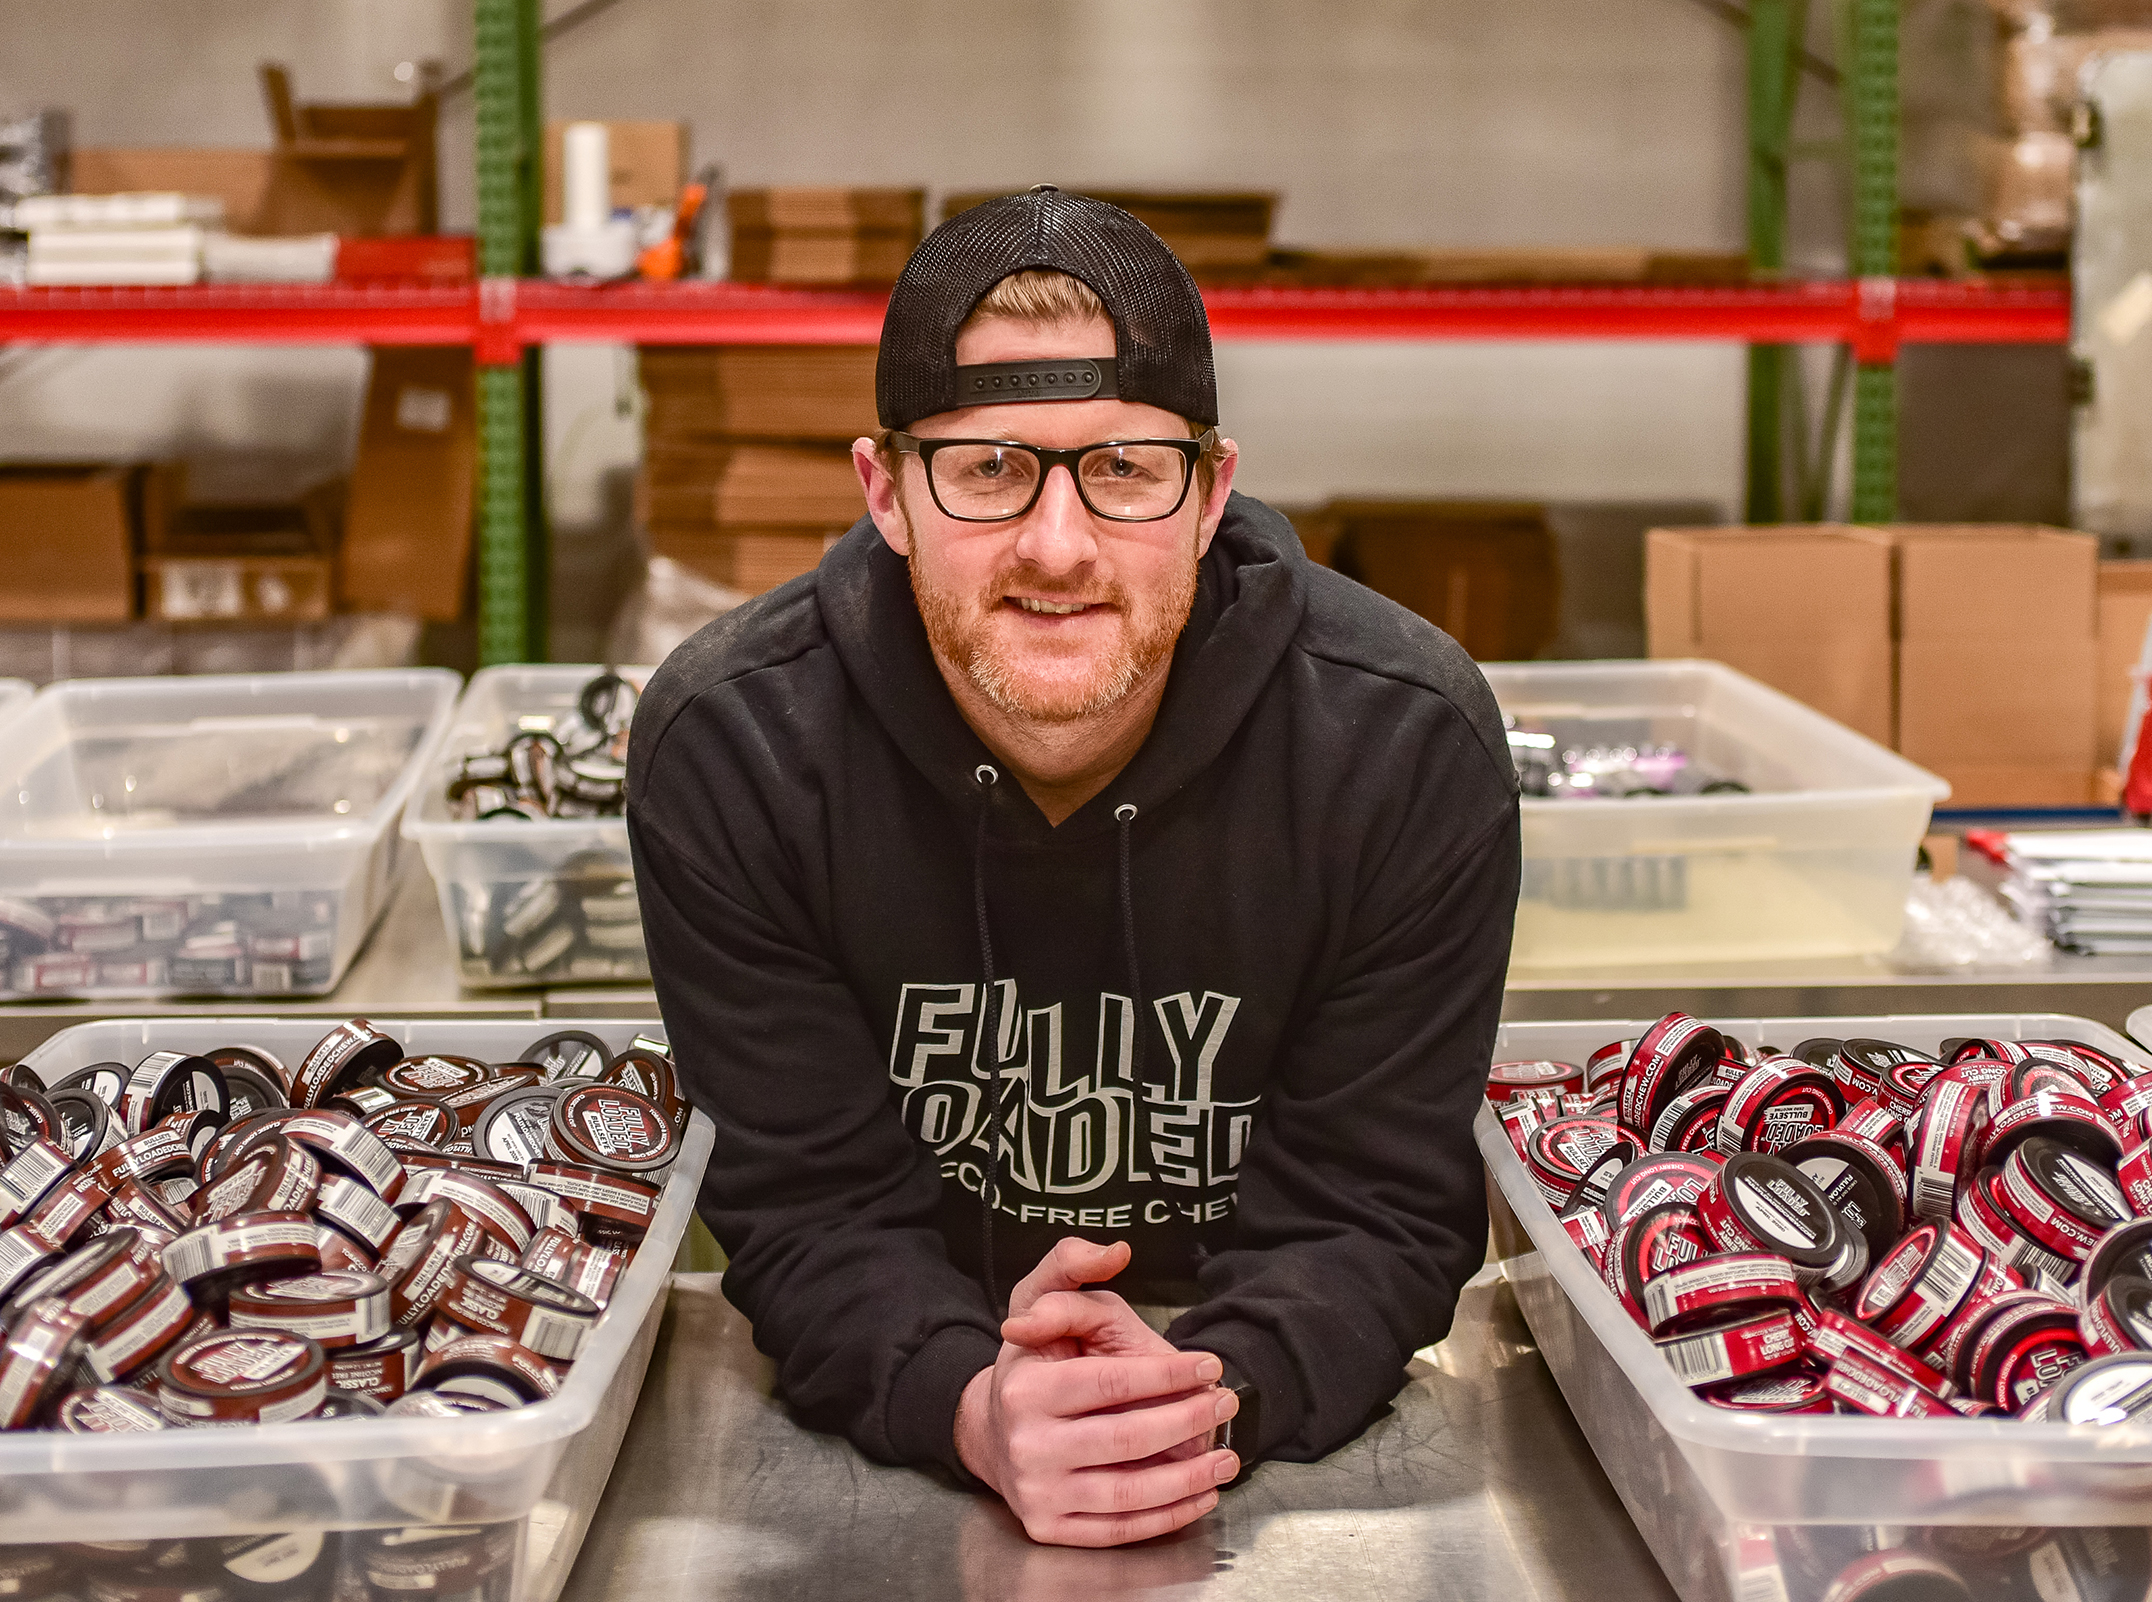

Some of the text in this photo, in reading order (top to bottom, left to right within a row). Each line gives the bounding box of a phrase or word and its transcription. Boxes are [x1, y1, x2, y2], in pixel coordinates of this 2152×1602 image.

[889, 978, 1241, 1112] FULLY
[308, 1043, 331, 1073] BULLSEYE
[1961, 1069, 1978, 1079] CUT
[1802, 1086, 1834, 1115] CUT LONG CHERRY
[1767, 1109, 1809, 1120] BULLSEYE
[256, 1115, 280, 1137] CLASSIC
[590, 1115, 616, 1152] BULLSEYE
[598, 1099, 633, 1153] LOADED
[617, 1105, 651, 1148] FULLY
[1681, 1118, 1704, 1151] FREE CHEW
[144, 1132, 171, 1146] BULLSEYE
[509, 1149, 519, 1162] 2020
[1641, 1167, 1661, 1180] LONG
[1659, 1163, 1685, 1173] CHERRY
[1629, 1174, 1643, 1187] CUT
[1846, 1179, 1858, 1190] CHECK
[1766, 1180, 1811, 1218] LOADED
[1774, 1178, 1809, 1208] FULLY
[1840, 1188, 1848, 1197] OUT
[2131, 1179, 2149, 1206] LONG
[1745, 1178, 1816, 1240] FULLYLOADEDCHEW.COM
[1755, 1204, 1785, 1232] APRIL 2020
[1719, 1219, 1735, 1234] CUT
[343, 1247, 367, 1272] TOBACCO
[459, 1295, 499, 1320] CLASSIC
[474, 1293, 506, 1312] NICOTINE
[475, 1313, 509, 1335] TOBACCO
[1763, 1329, 1790, 1344] CHERRY
[1760, 1341, 1783, 1356] LONG
[338, 1376, 380, 1390] CLASSIC
[349, 1367, 383, 1380] NICOTINE
[1998, 1354, 2018, 1404] CHERRY LONG
